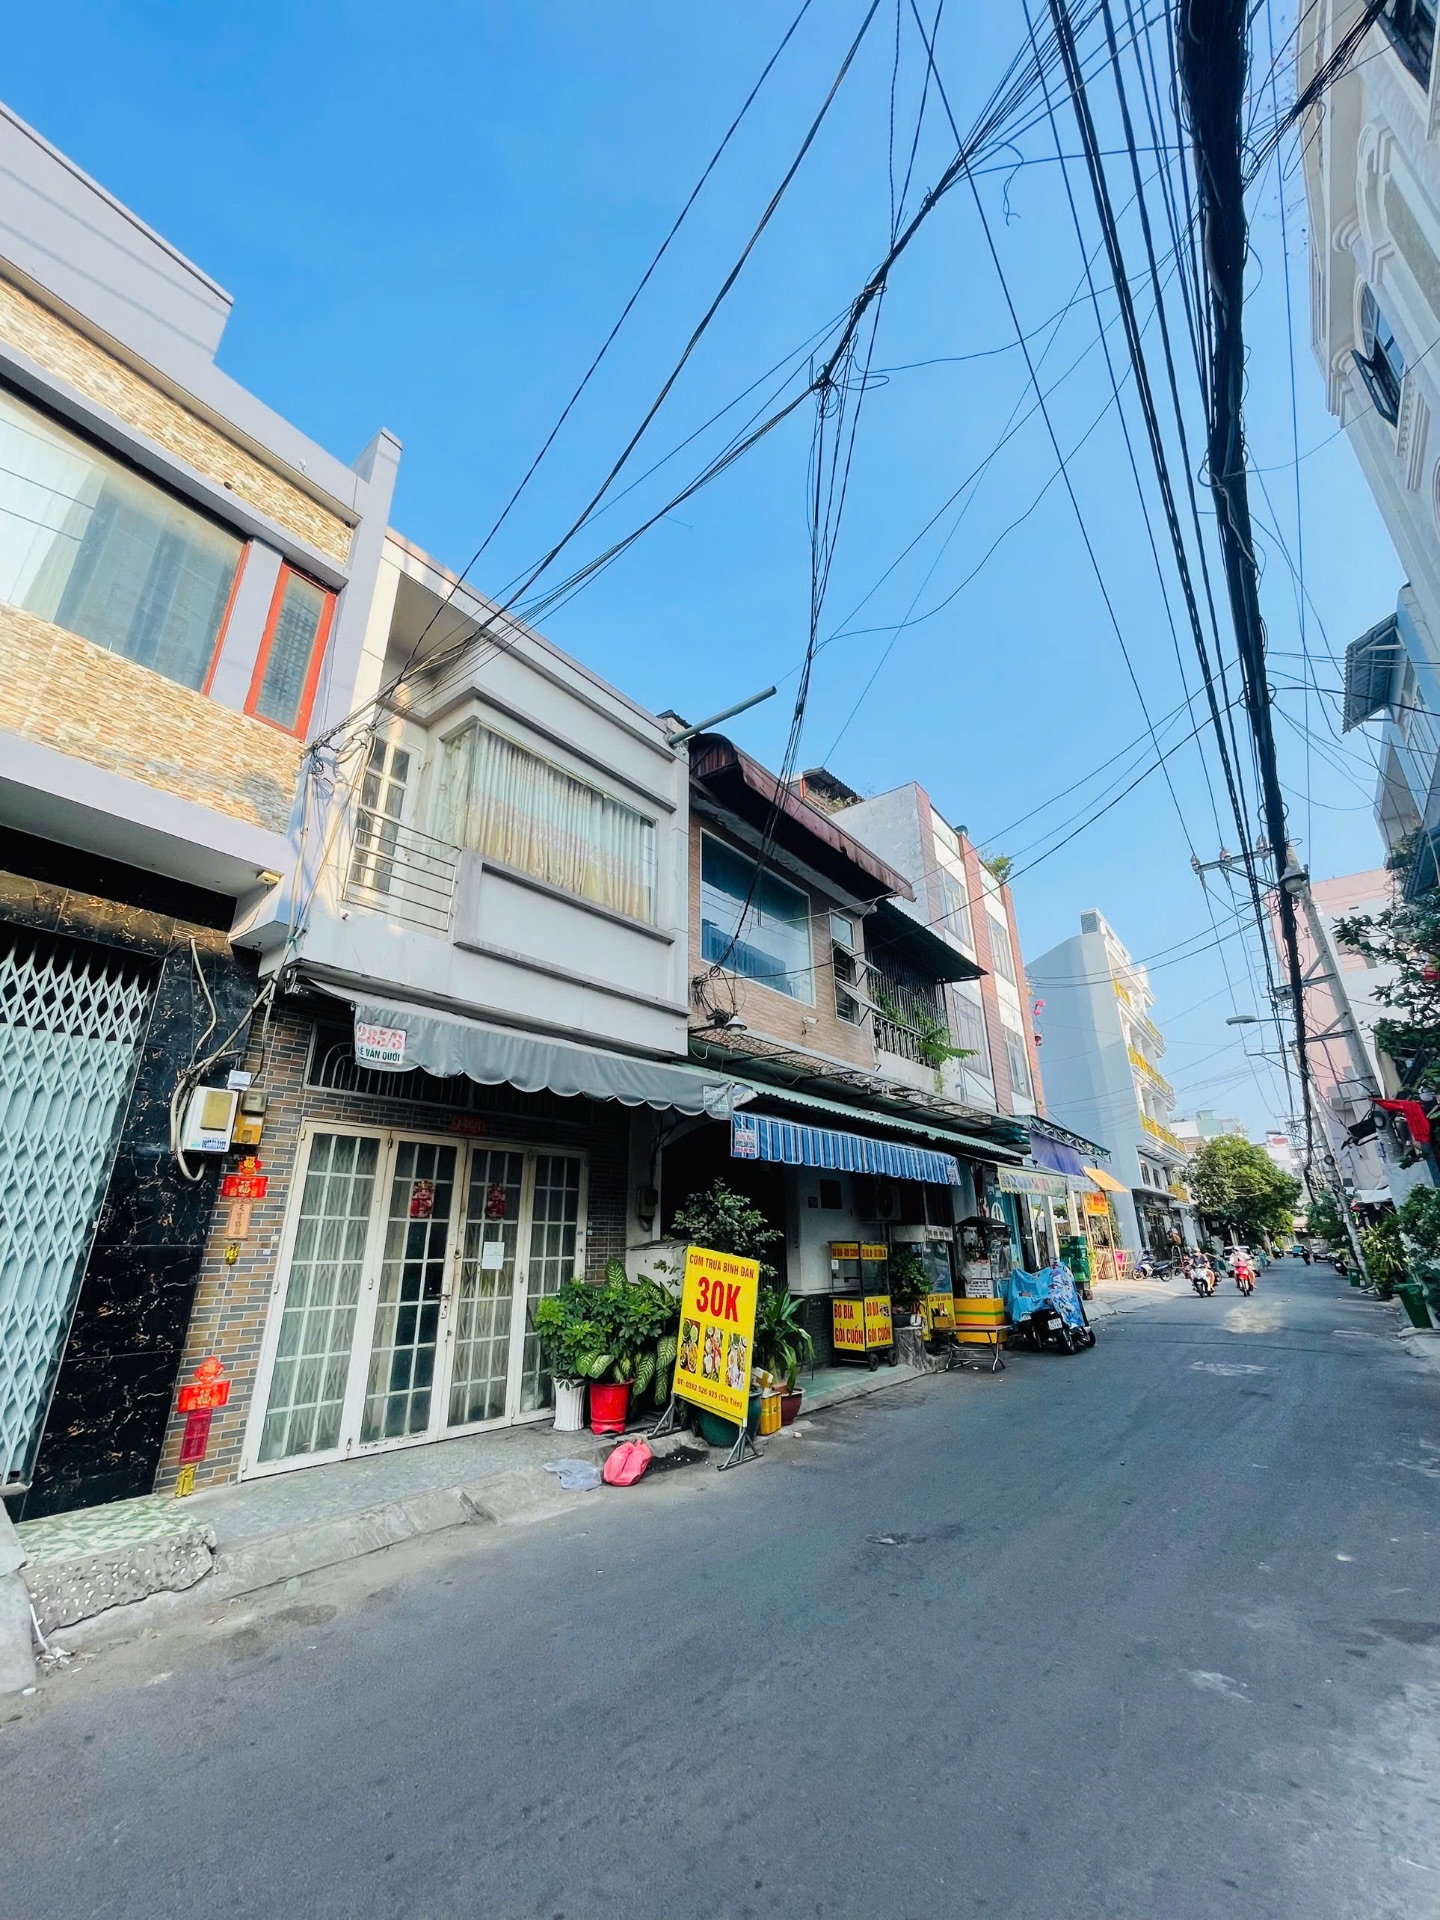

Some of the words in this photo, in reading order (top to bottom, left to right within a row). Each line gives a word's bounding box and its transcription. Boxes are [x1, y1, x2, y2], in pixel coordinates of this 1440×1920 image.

[366, 1048, 380, 1059] VĂN
[696, 1276, 742, 1323] 30K
[846, 1324, 864, 1345] CUỐN
